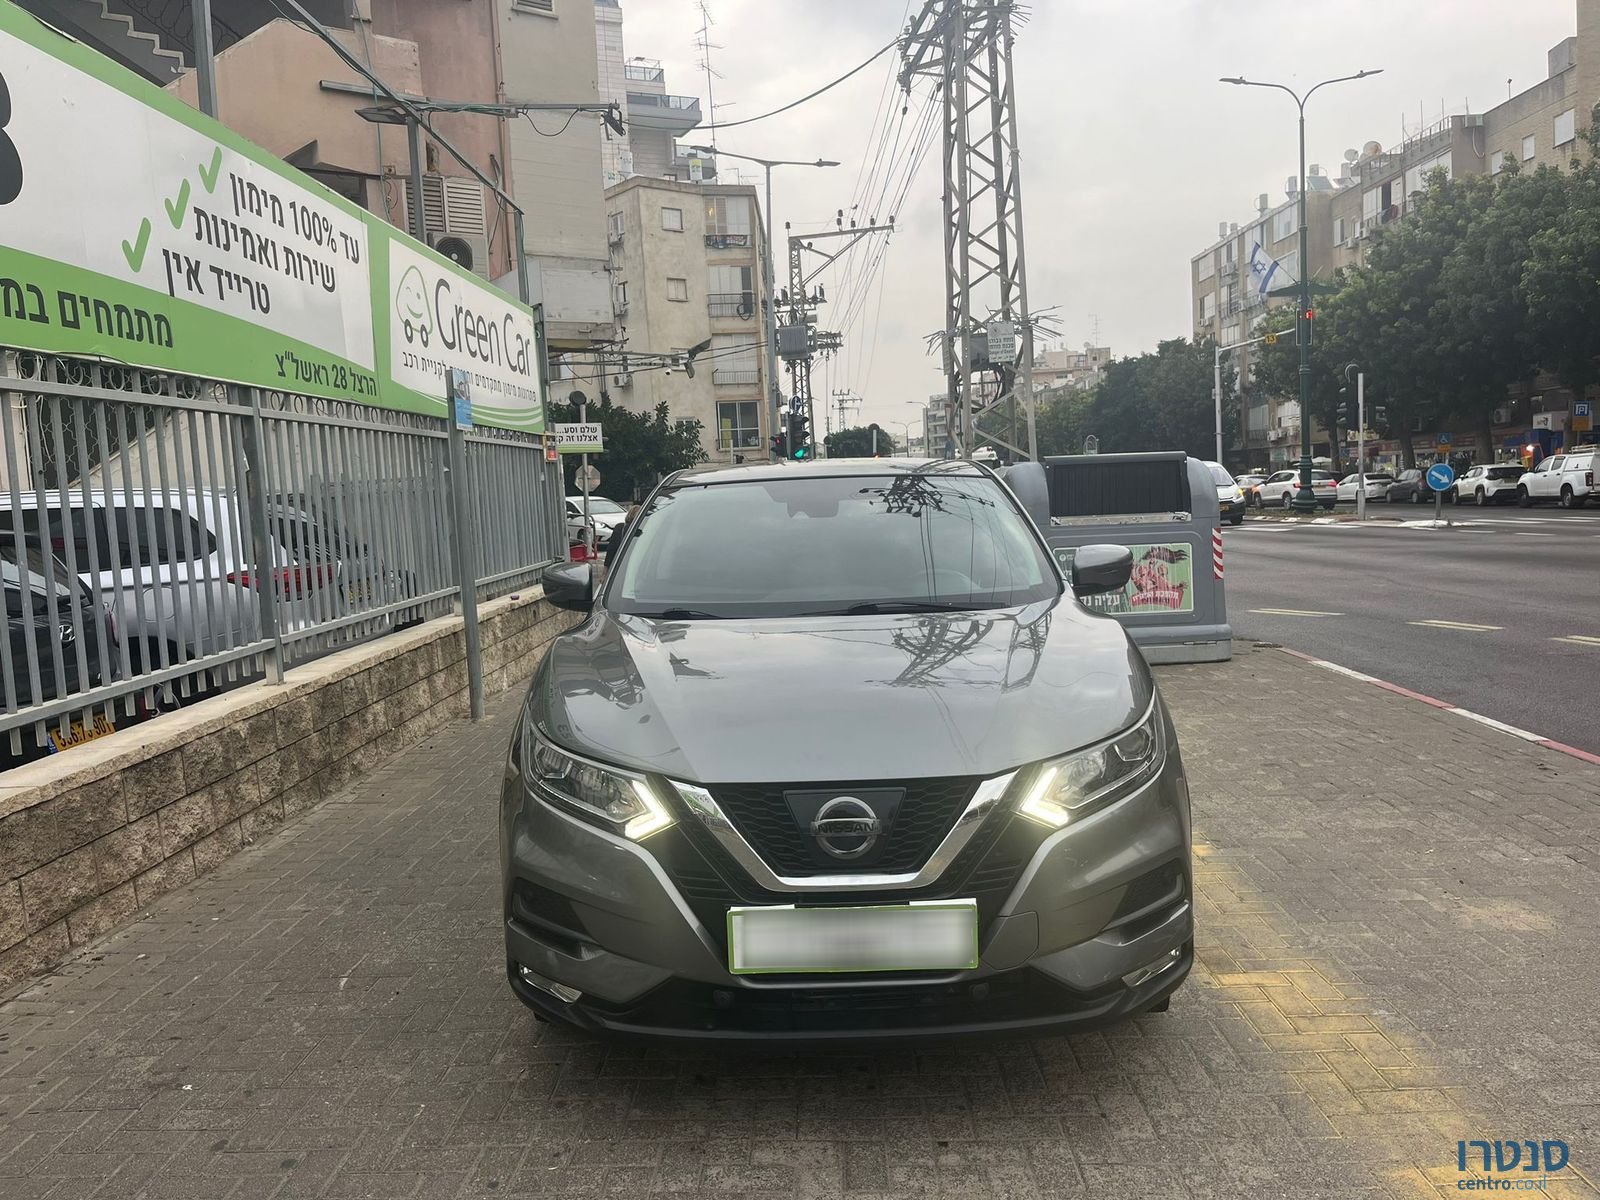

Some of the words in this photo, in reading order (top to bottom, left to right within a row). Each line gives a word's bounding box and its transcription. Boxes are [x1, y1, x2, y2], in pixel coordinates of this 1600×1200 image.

[230, 172, 285, 228] מימון
[194, 206, 279, 271] ואמינות
[289, 201, 337, 253] 100%
[340, 231, 359, 264] עד
[162, 248, 204, 297] אין
[209, 264, 270, 314] טרייד
[283, 245, 336, 293] שירות
[0, 278, 50, 325] במ
[57, 290, 174, 348] מתמחים
[435, 278, 501, 366] Green
[503, 312, 530, 377] Car
[331, 363, 348, 390] 28
[349, 366, 377, 397] הרצל
[402, 351, 419, 371] רכב
[576, 433, 598, 442] אצלנו
[580, 425, 598, 434] שלם
[817, 823, 875, 833] NISSAN
